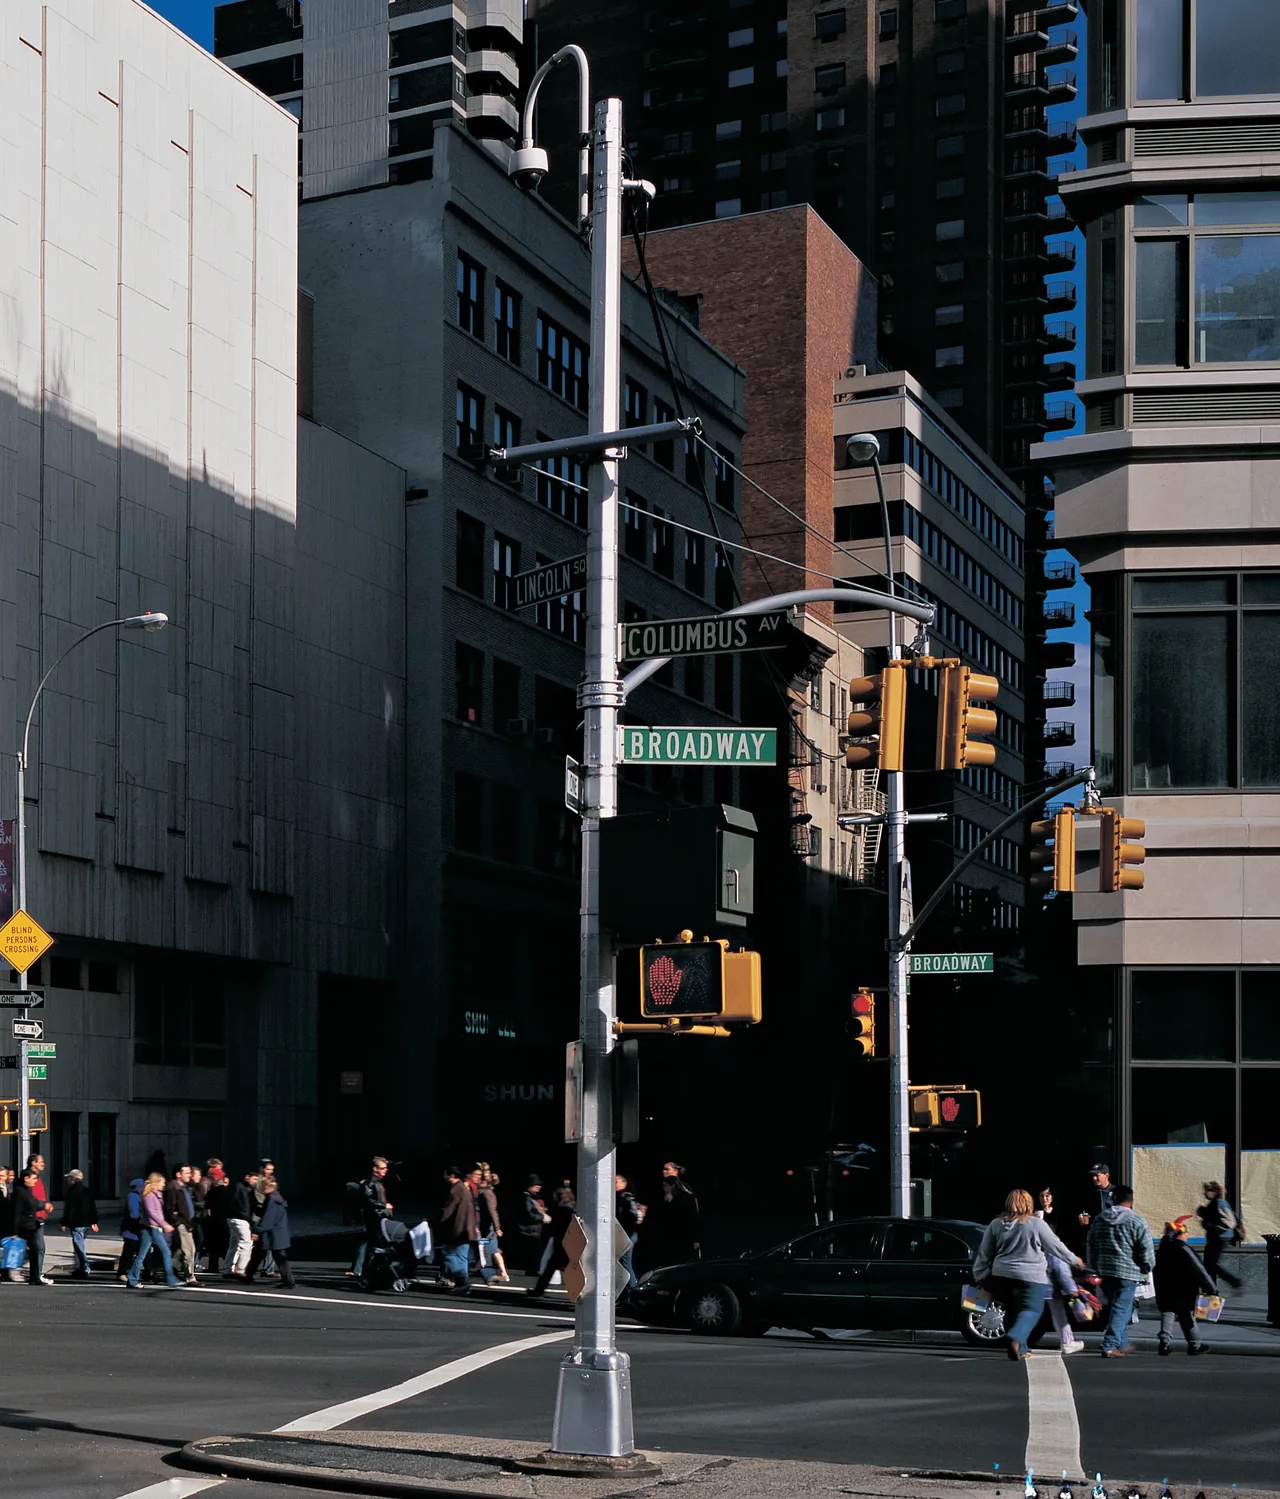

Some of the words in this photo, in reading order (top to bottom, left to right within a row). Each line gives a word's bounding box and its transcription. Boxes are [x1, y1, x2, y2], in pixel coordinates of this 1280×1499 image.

[517, 564, 571, 605] LINCOLN
[573, 559, 586, 574] SQ
[628, 619, 748, 656] COLUMBUS
[758, 616, 780, 632] AV
[631, 732, 766, 760] BROADWAY
[6, 936, 38, 944] PERSONS
[4, 945, 39, 953] CROSSING
[914, 955, 988, 971] BROADWAY
[1, 995, 15, 1003] ONE
[23, 995, 39, 1003] WAY
[17, 1025, 26, 1033] ONE
[464, 1010, 489, 1035] SHU
[483, 1083, 554, 1101] SHUN
